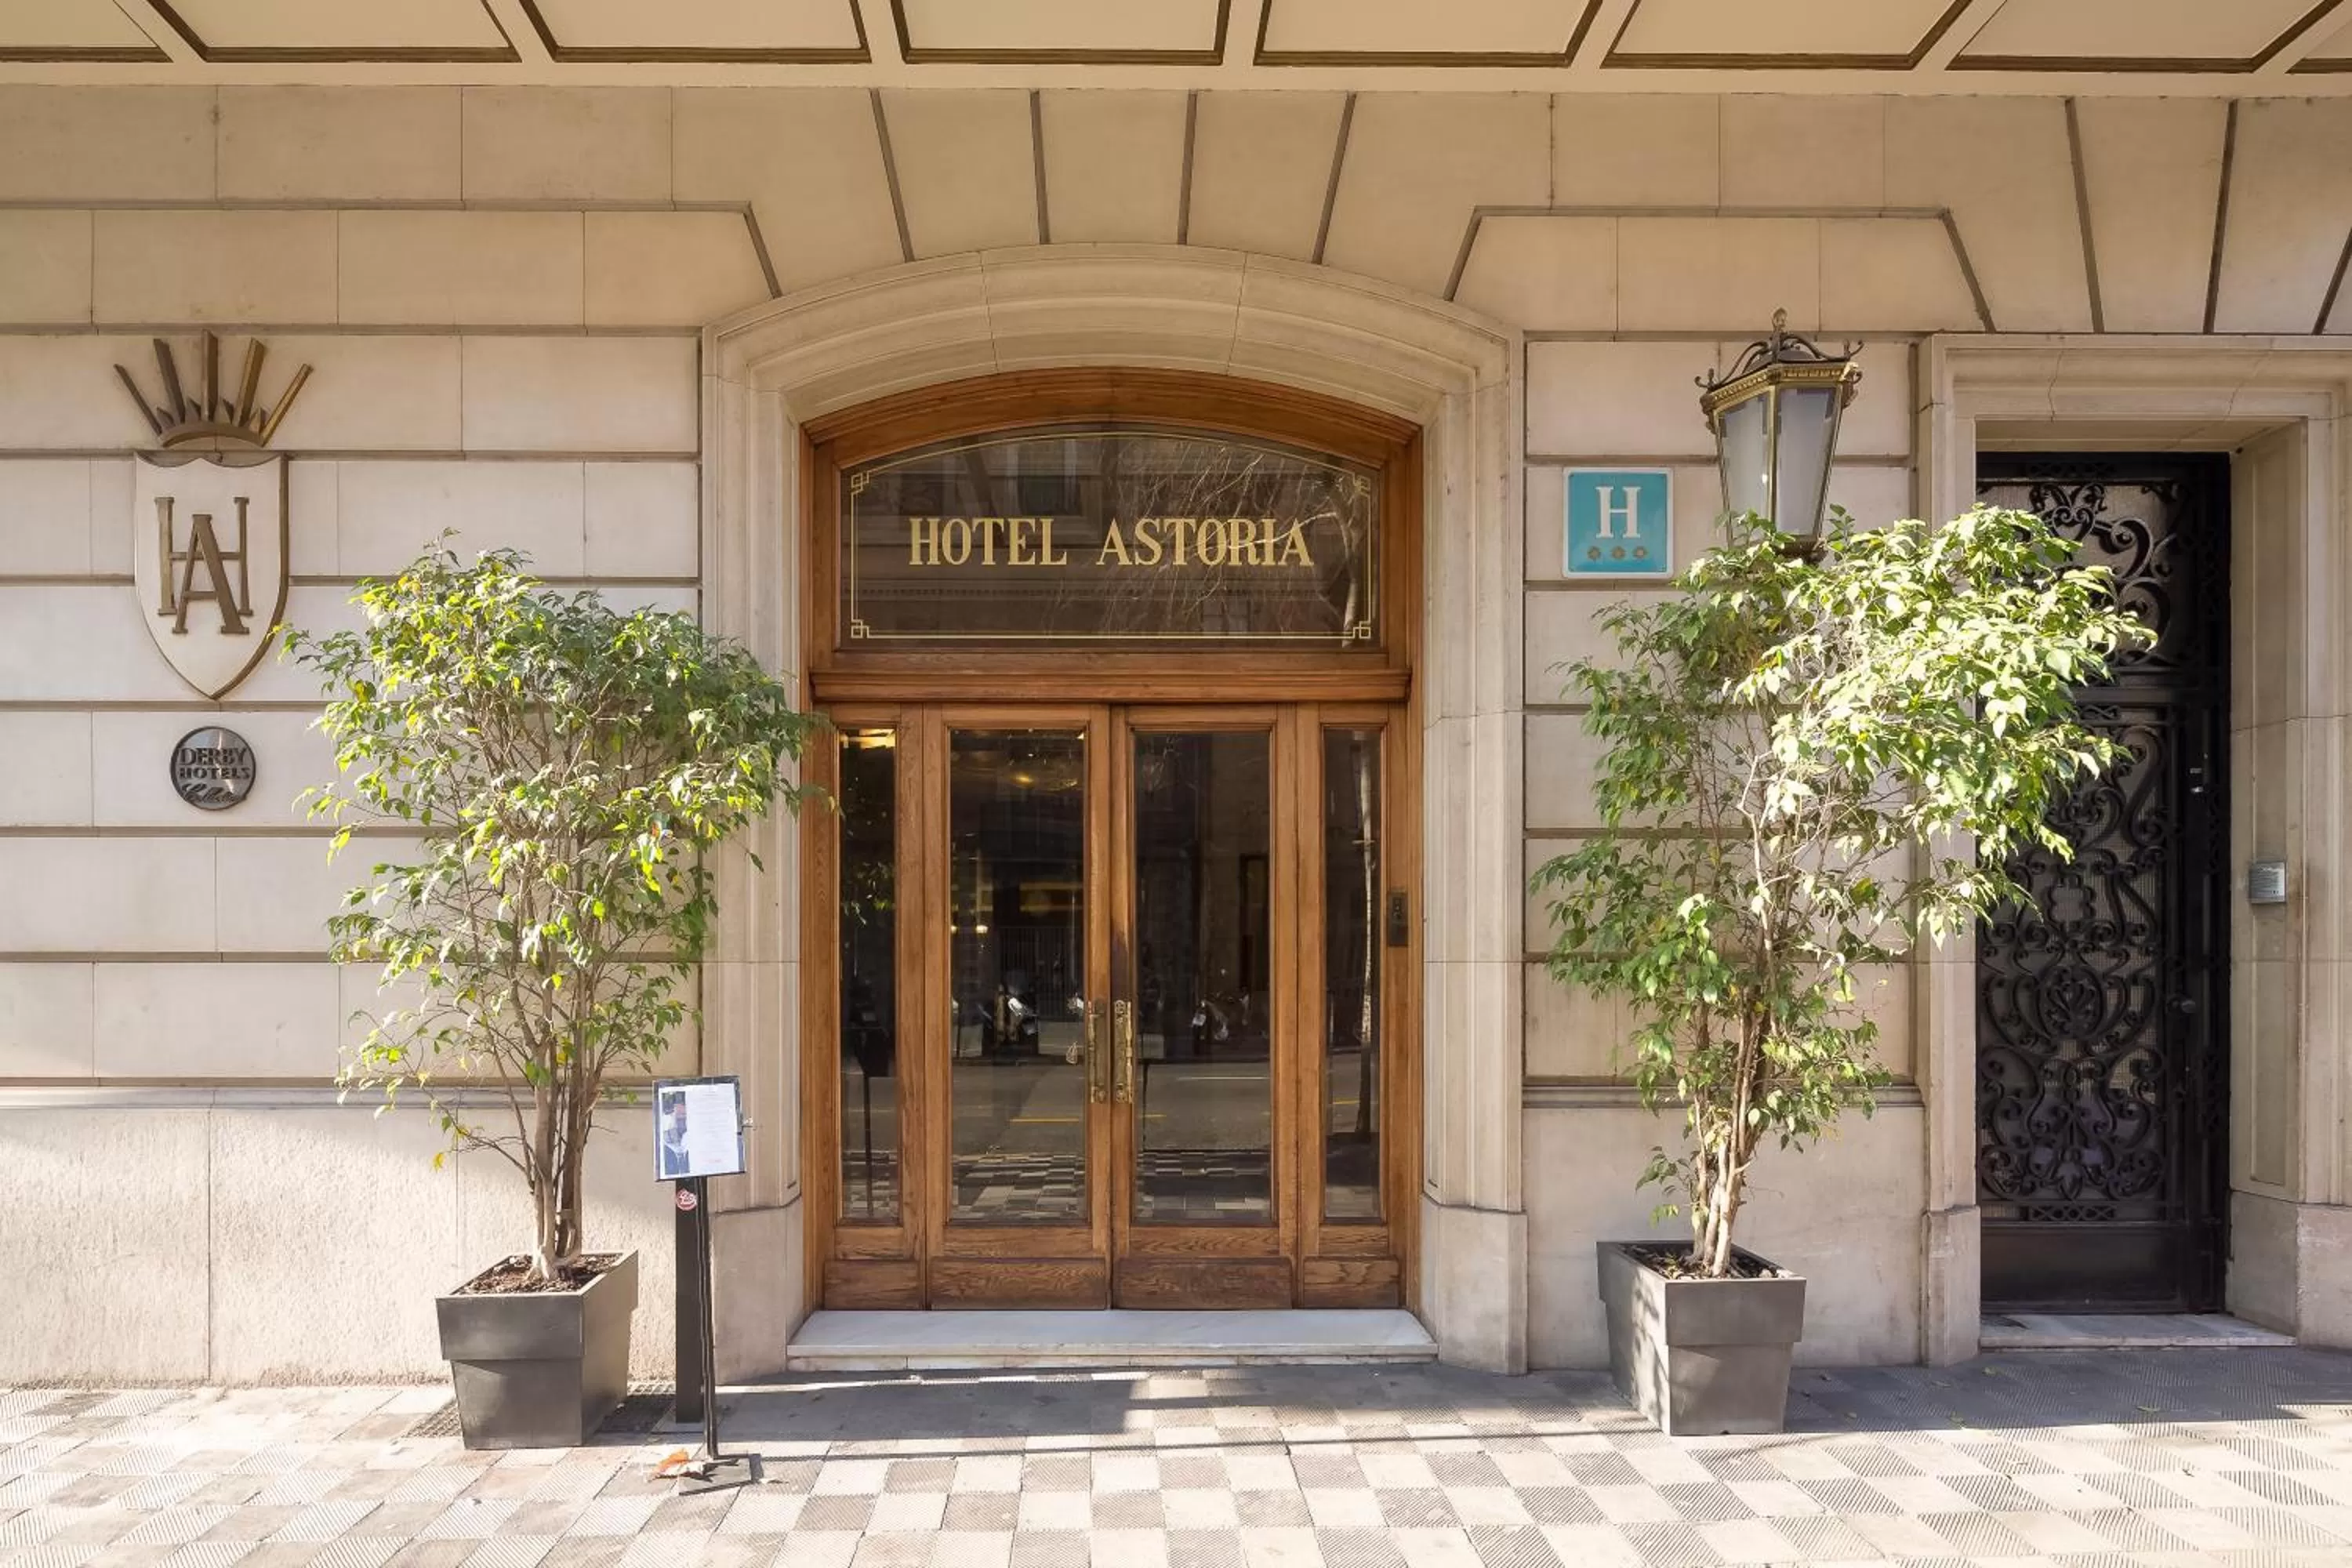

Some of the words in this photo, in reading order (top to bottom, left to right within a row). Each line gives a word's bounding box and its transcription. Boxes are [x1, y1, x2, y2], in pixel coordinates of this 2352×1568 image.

[1595, 485, 1642, 539] H
[909, 517, 1067, 566] HOTEL
[1096, 517, 1314, 566] ASTORIA
[179, 747, 247, 766] DERBY
[179, 767, 251, 780] HOTELS
